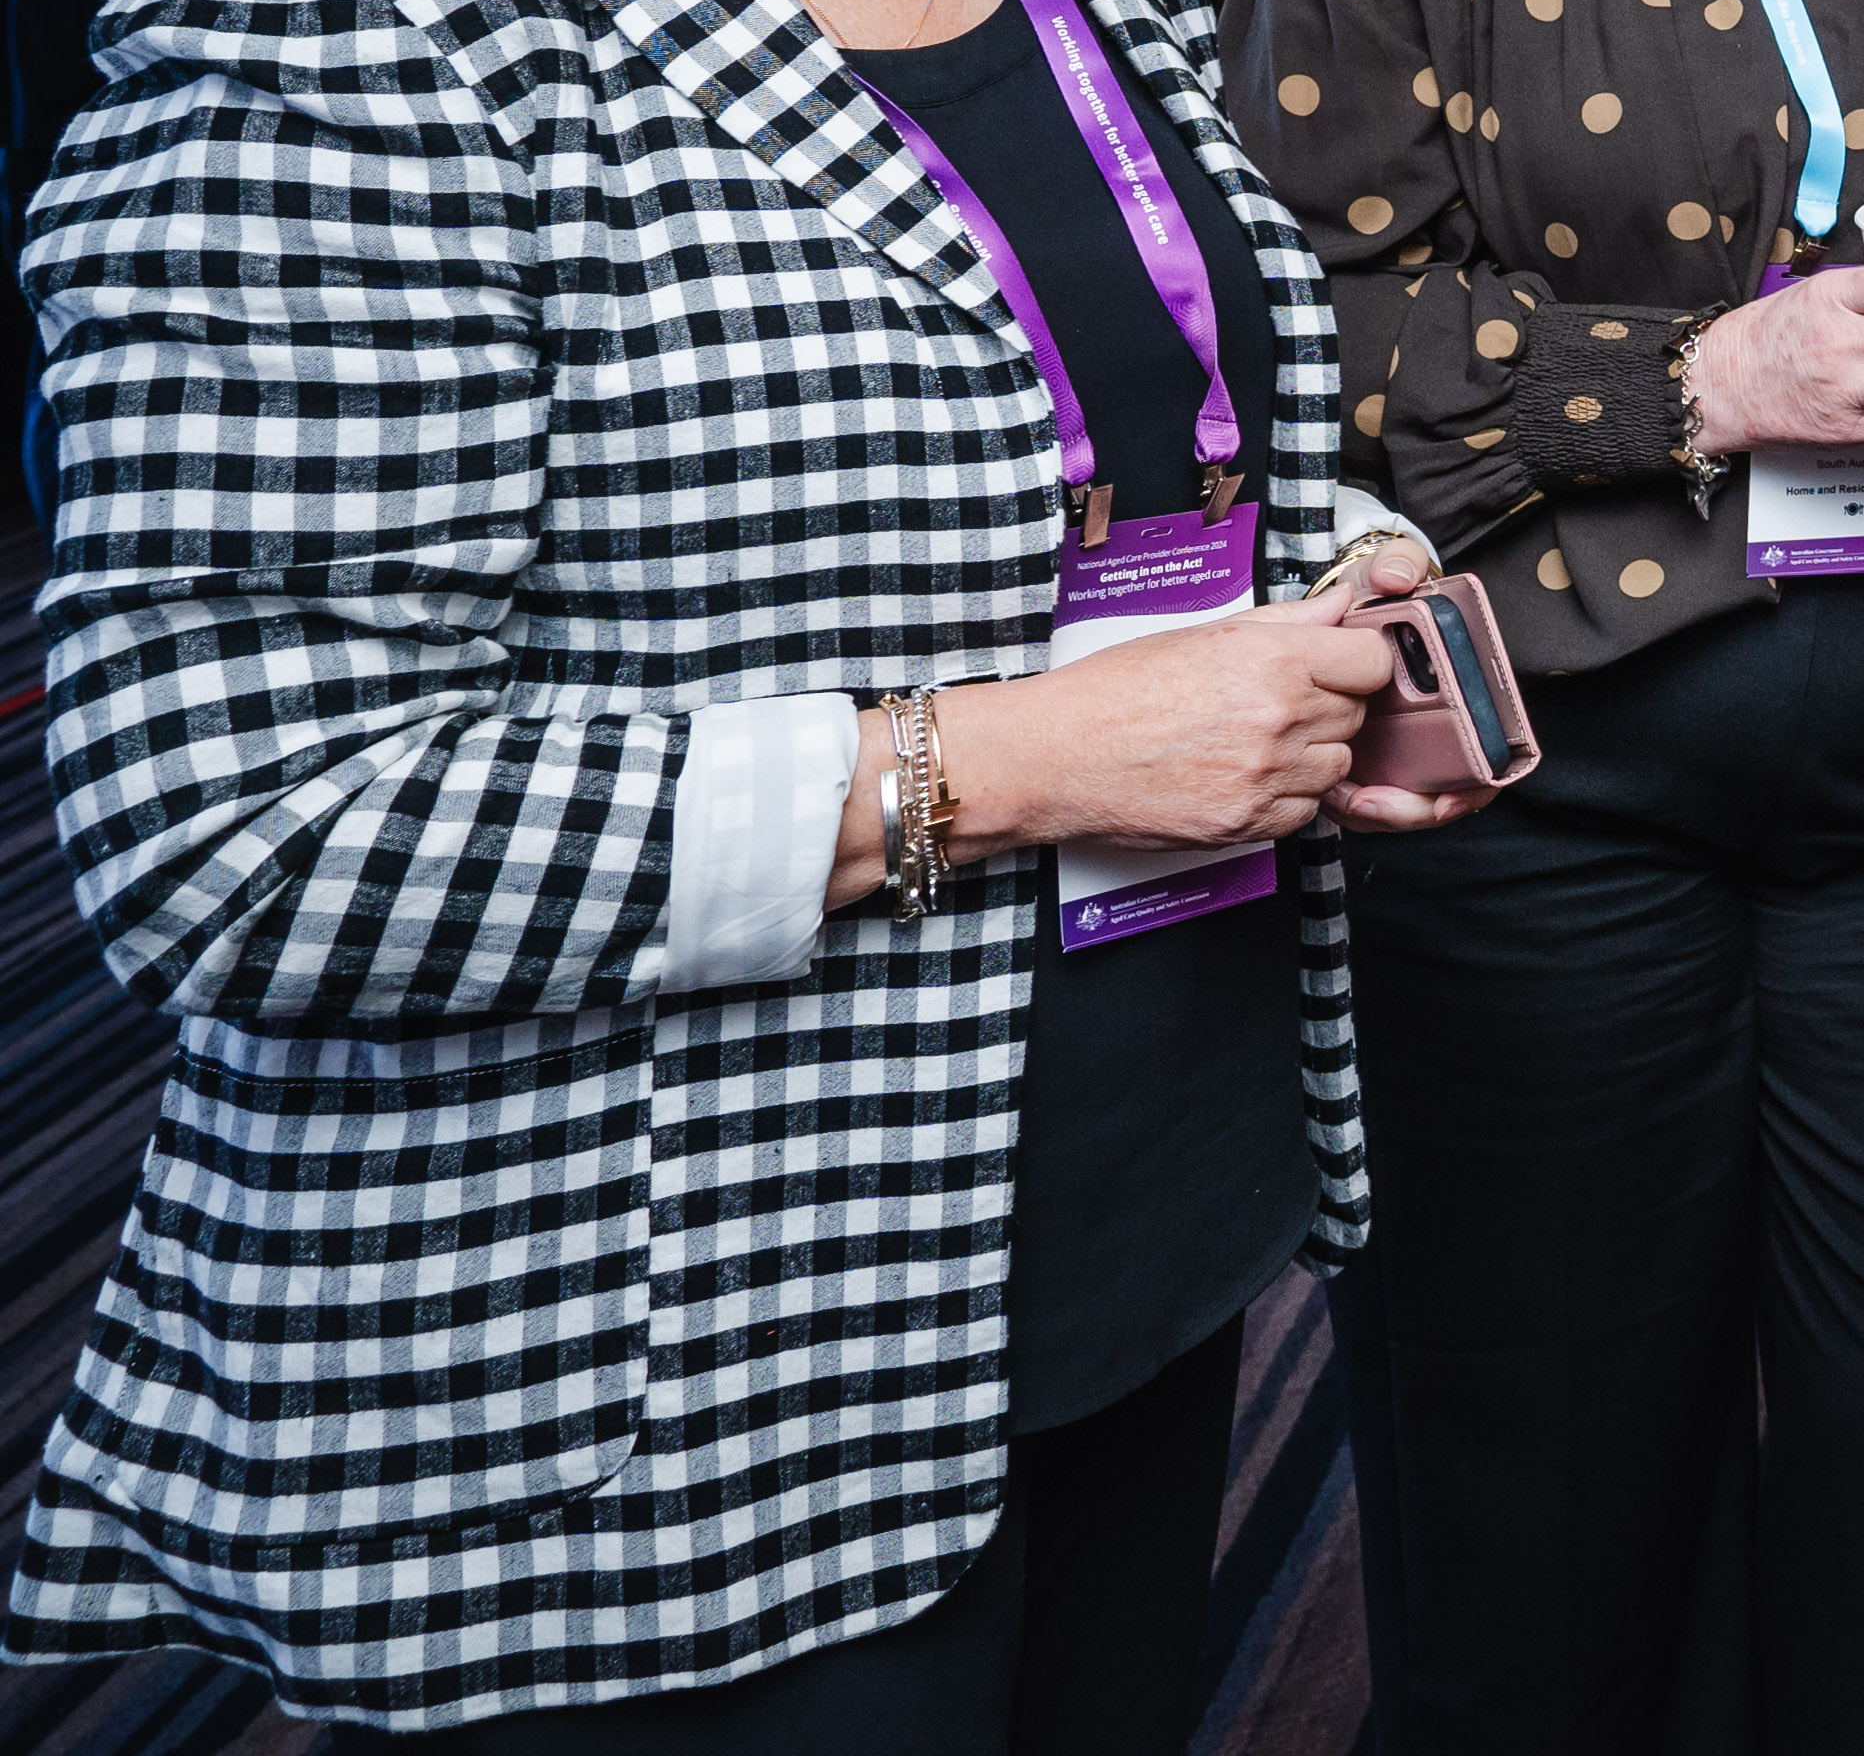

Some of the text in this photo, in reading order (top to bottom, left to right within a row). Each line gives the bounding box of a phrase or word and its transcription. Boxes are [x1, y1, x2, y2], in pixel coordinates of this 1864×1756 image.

[1051, 16, 1169, 245] Working together for better aged care
[1817, 458, 1846, 469] South
[1786, 486, 1815, 496] Home
[1817, 484, 1836, 495] and
[1077, 539, 1227, 570] National Aged Care Provider Conference 2024
[1100, 557, 1203, 583] Getting in on the Act!
[1067, 567, 1231, 603] Working together for better aged care
